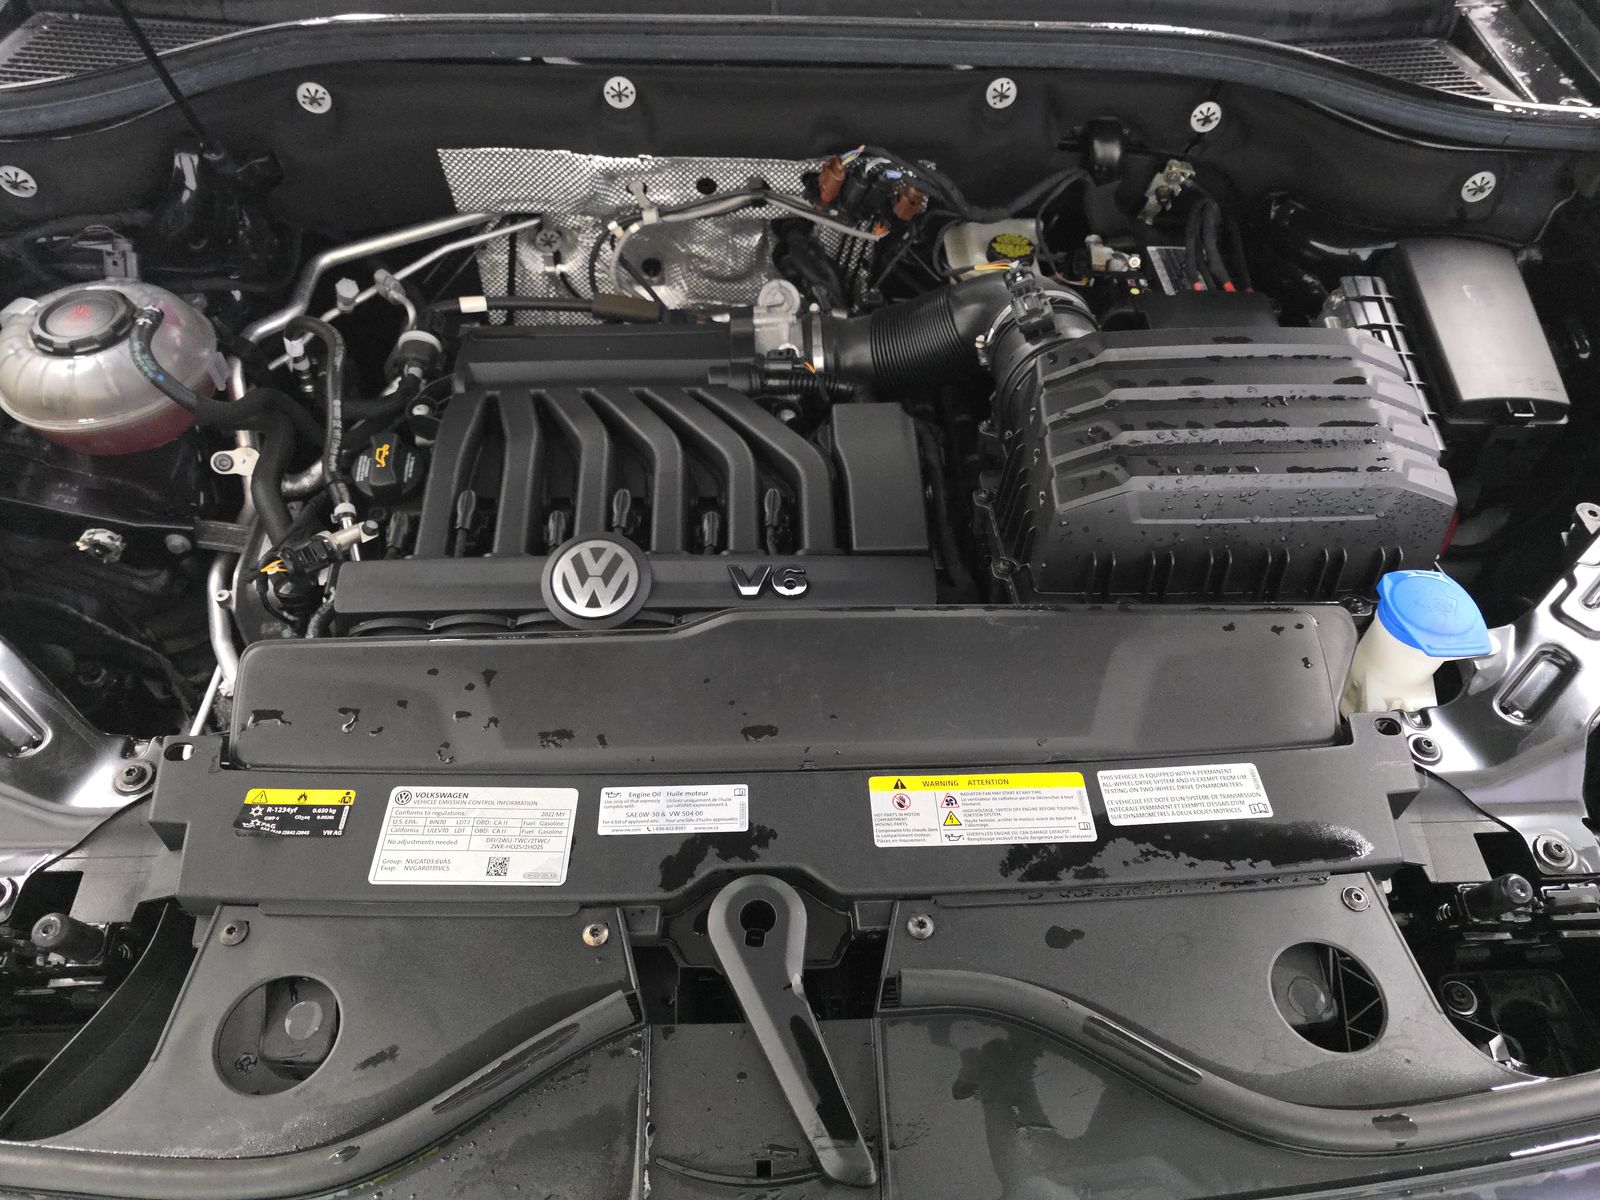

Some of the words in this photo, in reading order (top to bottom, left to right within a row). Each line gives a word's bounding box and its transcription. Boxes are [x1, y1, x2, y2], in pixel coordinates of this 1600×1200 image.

[727, 564, 808, 597] V6
[967, 778, 1009, 786] ATTENTION
[267, 806, 298, 814] R-1234yf
